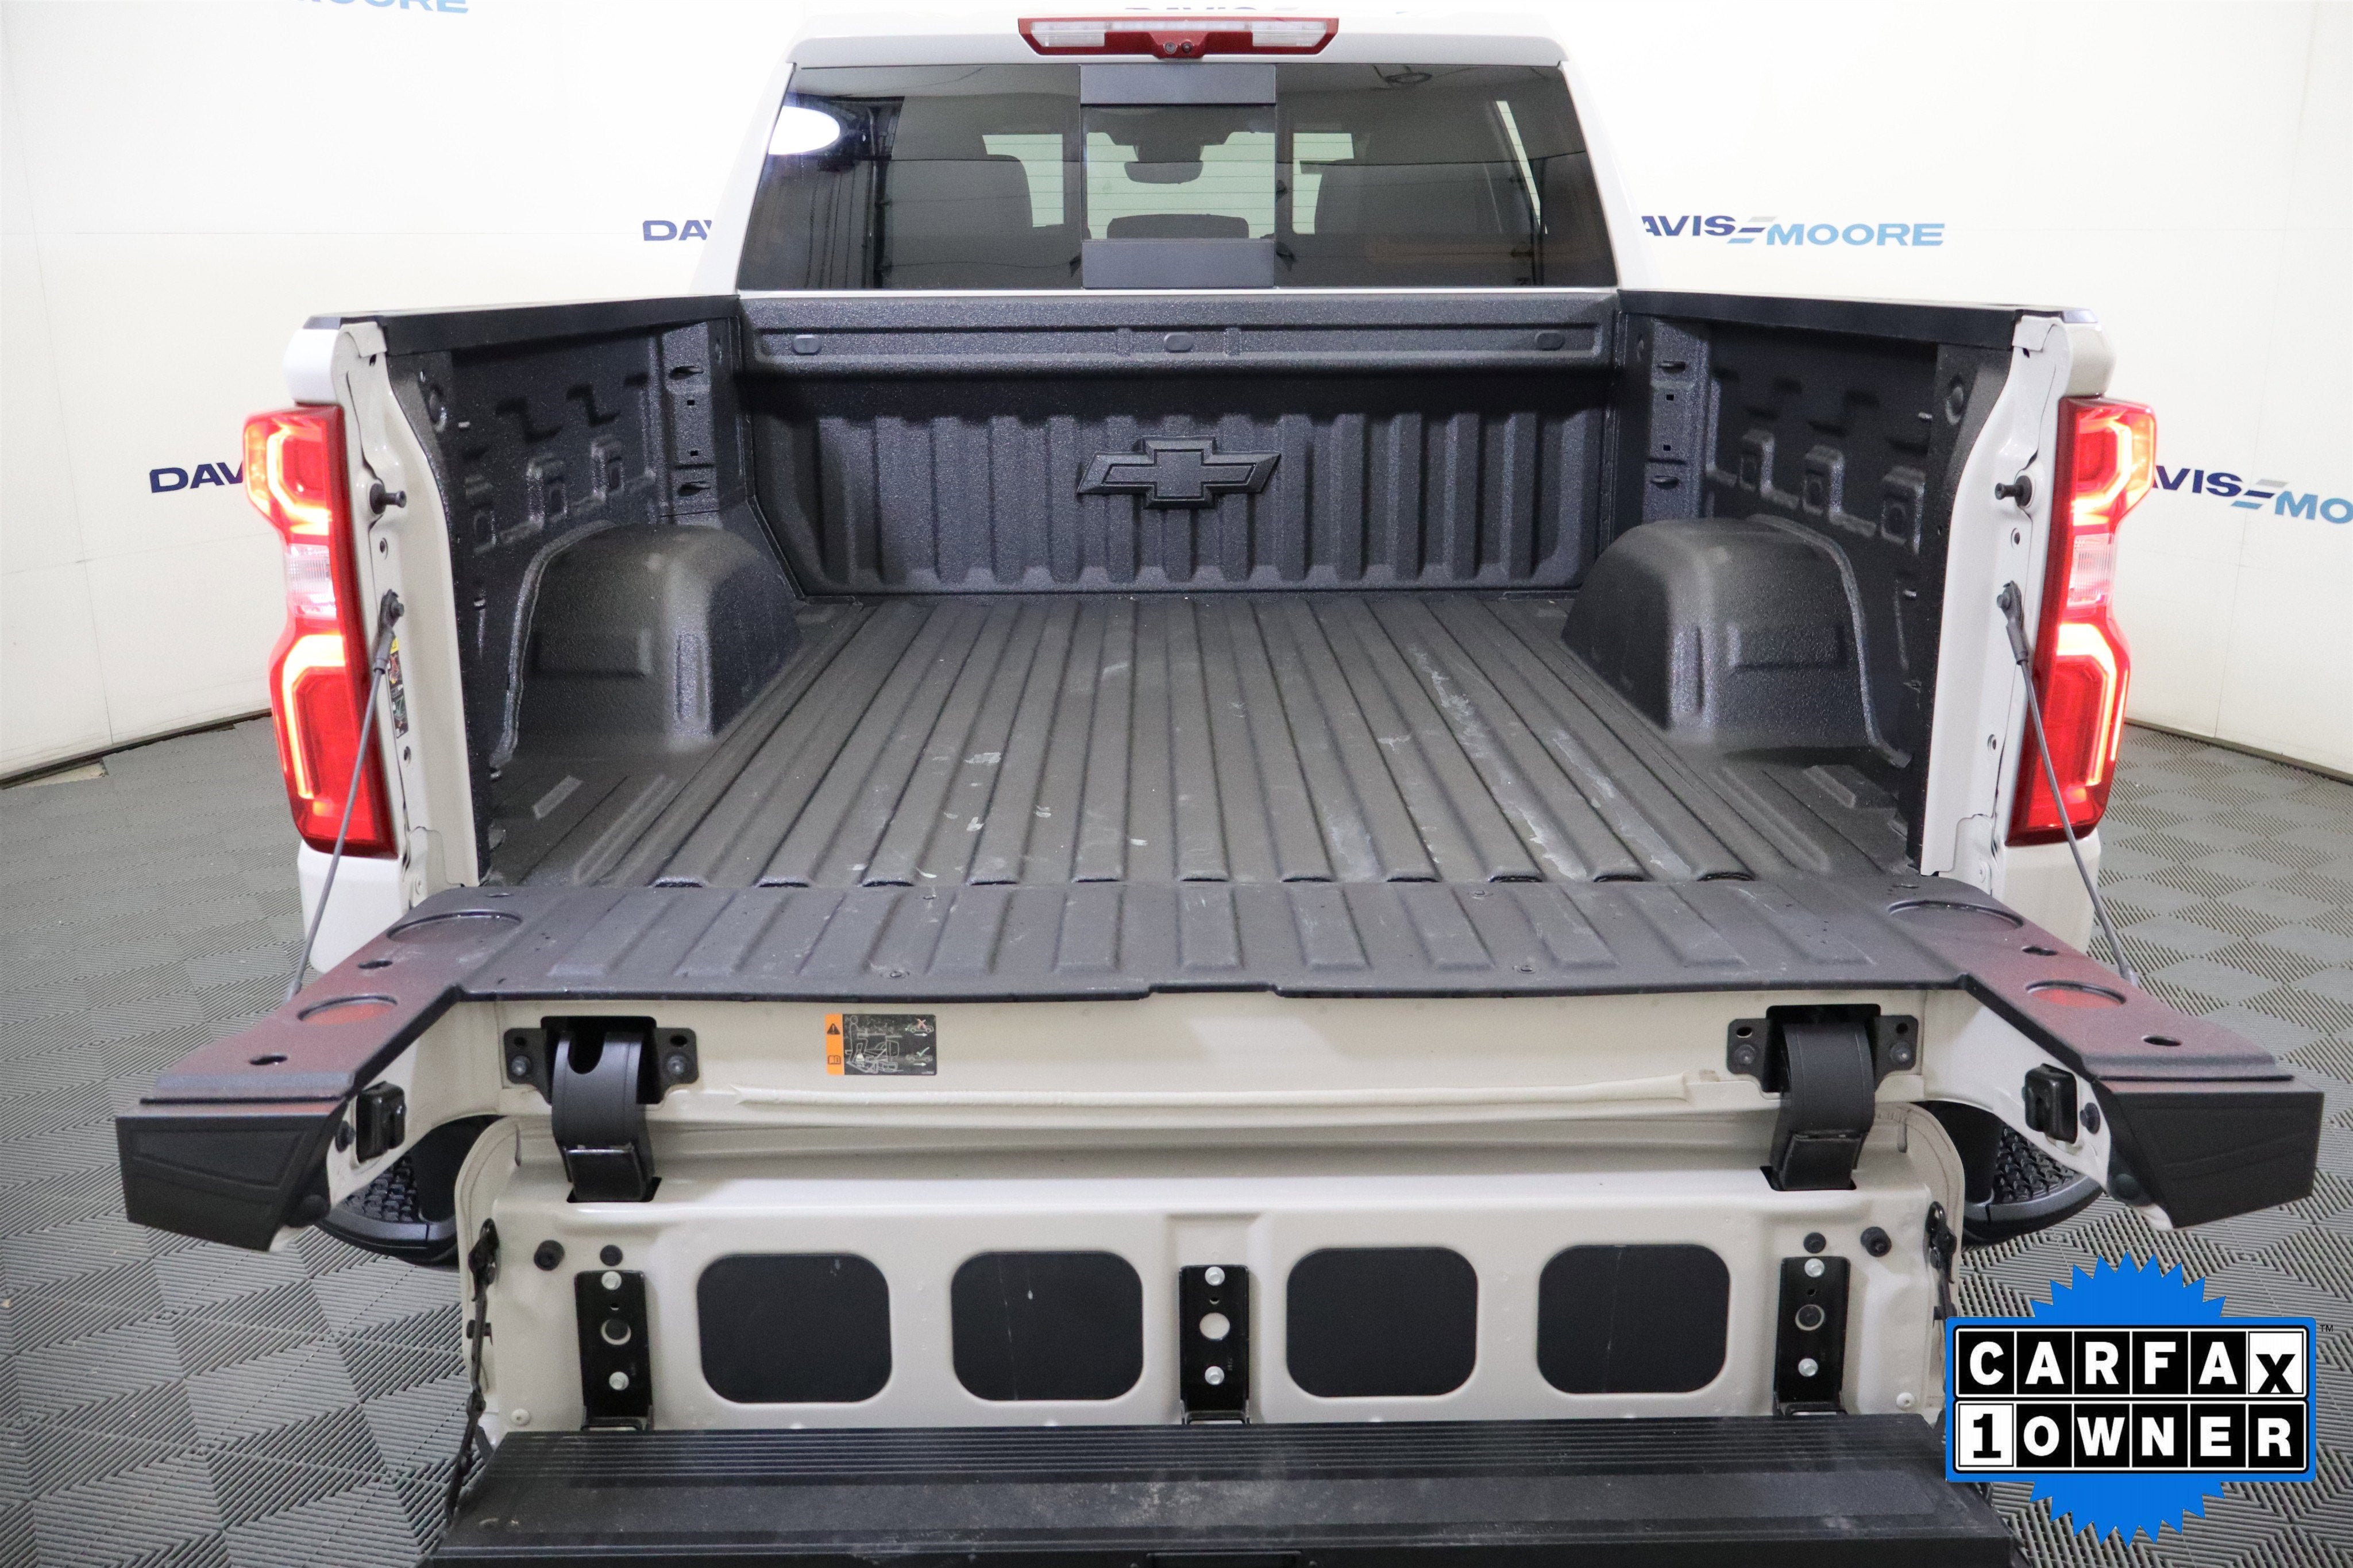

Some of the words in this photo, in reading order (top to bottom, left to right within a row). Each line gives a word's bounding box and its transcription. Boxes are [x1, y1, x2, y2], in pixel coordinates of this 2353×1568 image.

[643, 220, 712, 241] DA
[1766, 223, 1945, 246] MOORE
[2151, 465, 2243, 497] VIS
